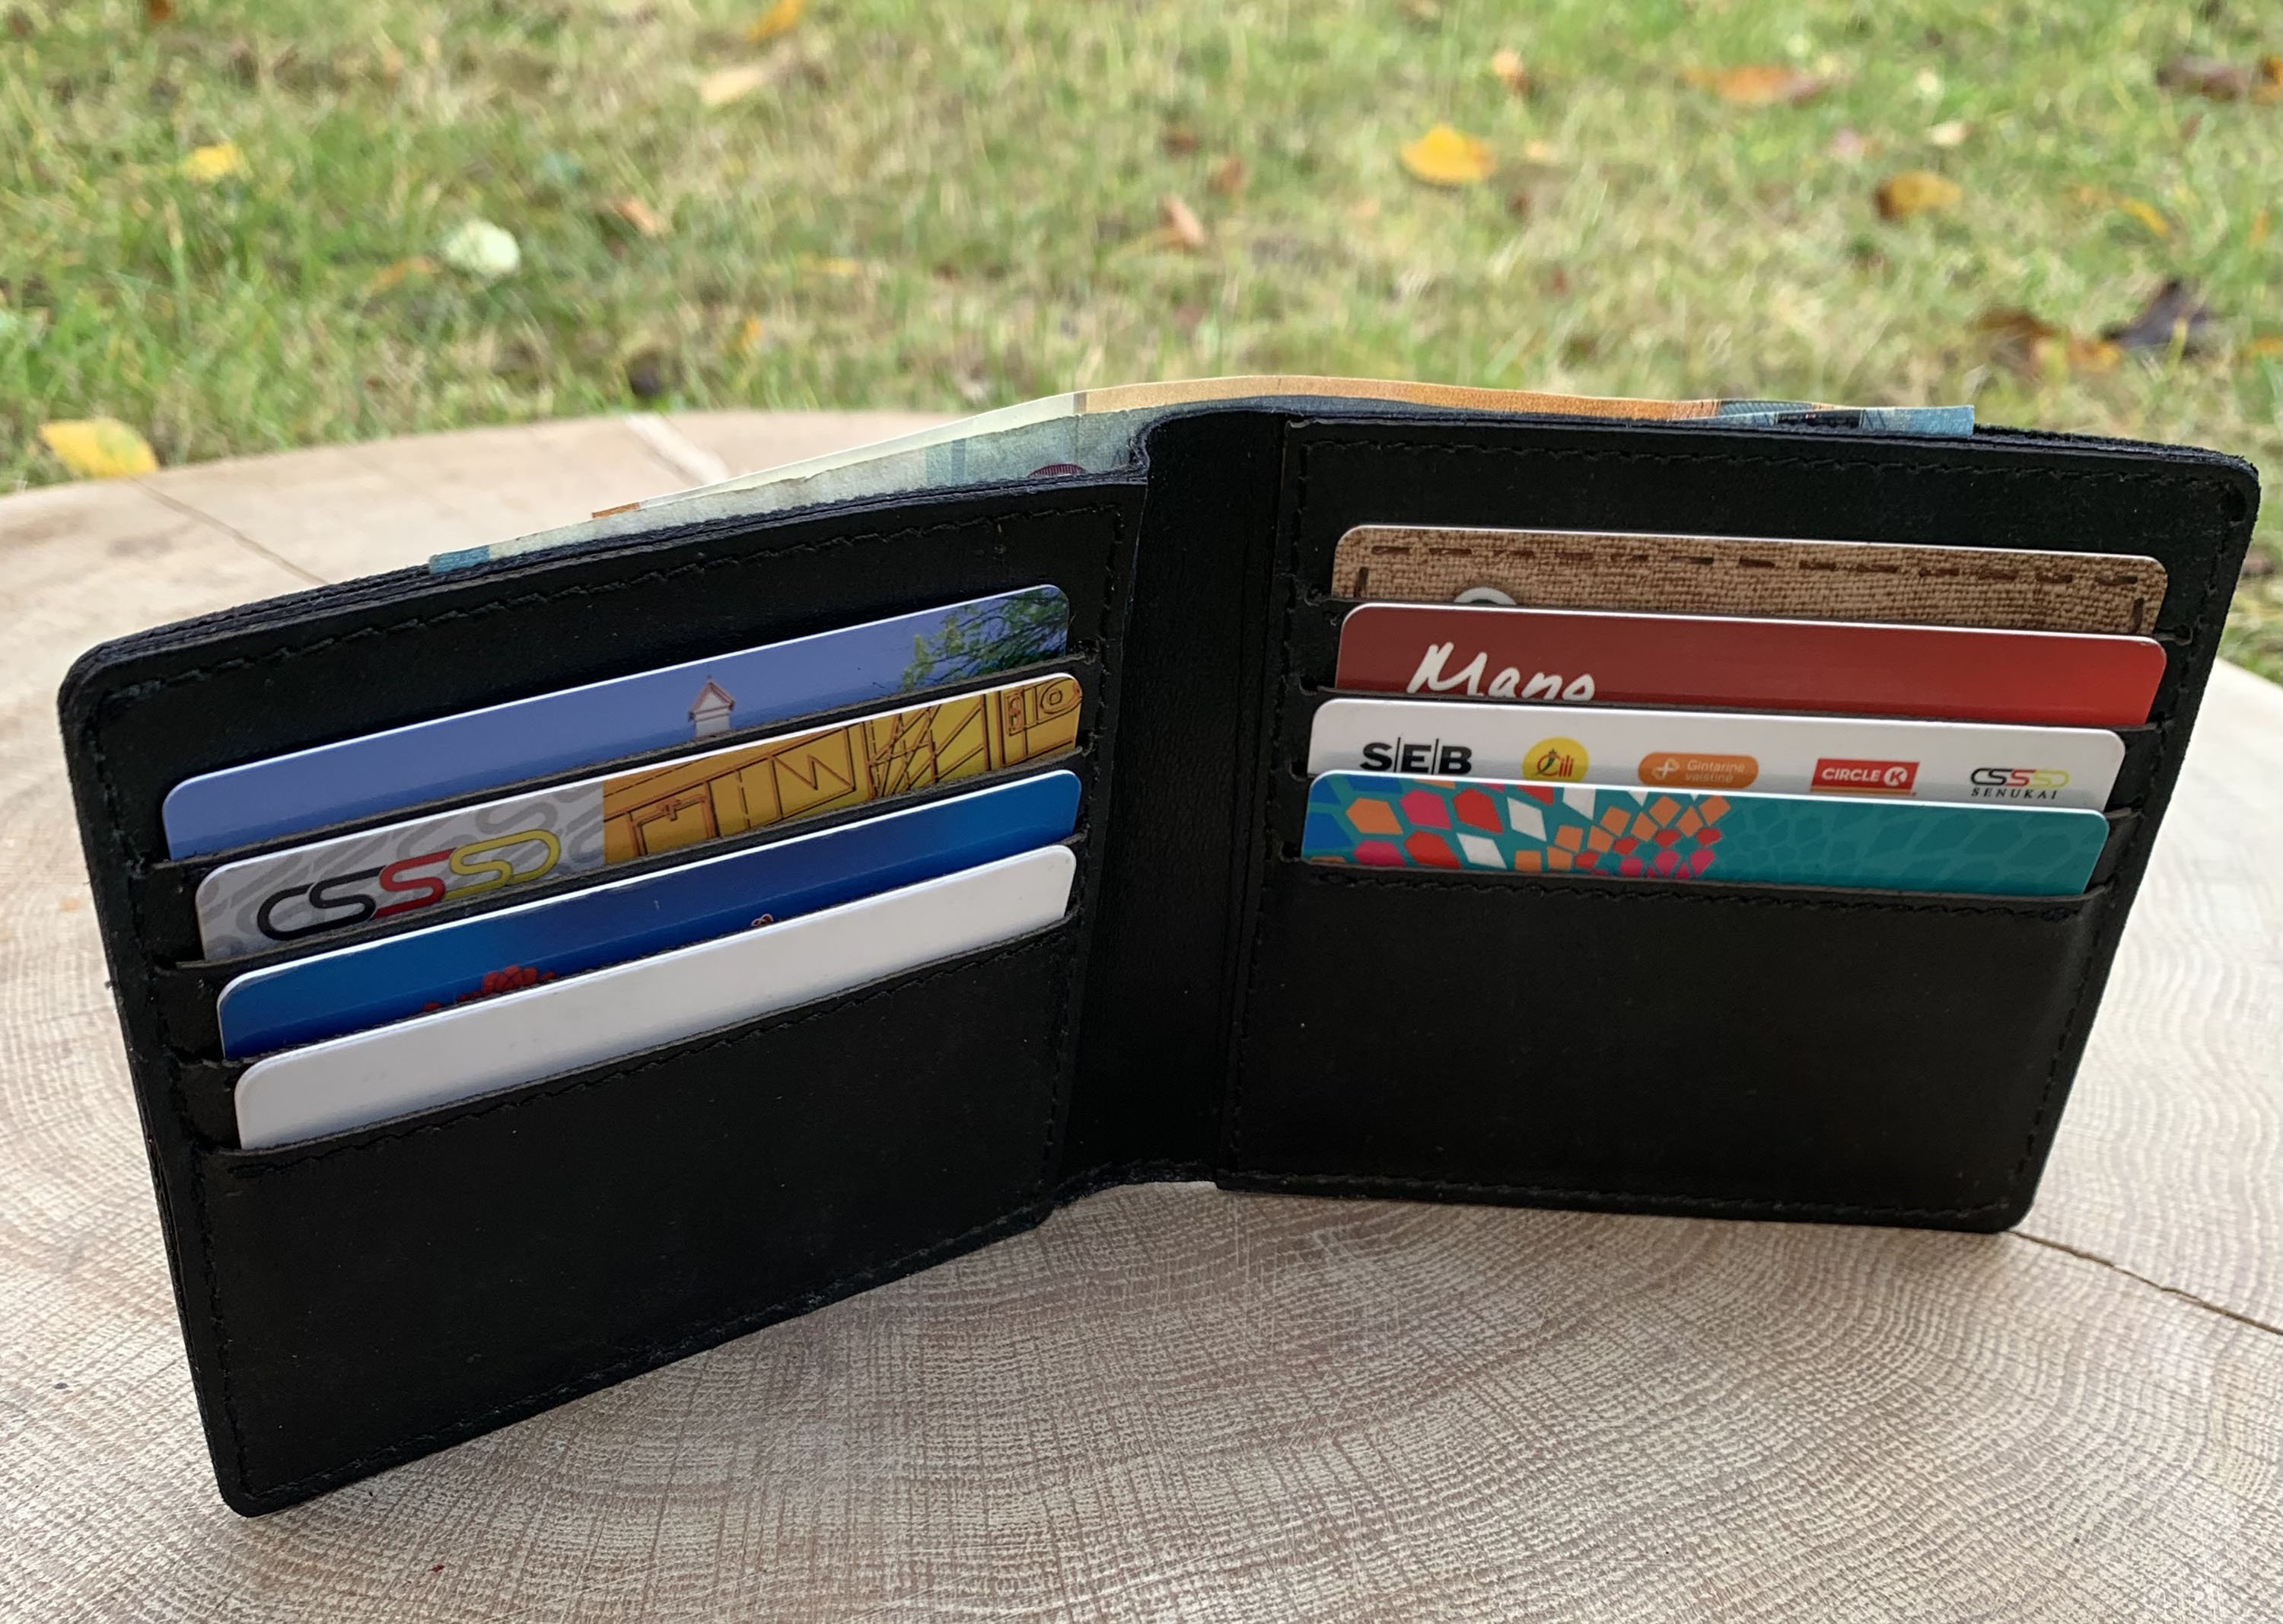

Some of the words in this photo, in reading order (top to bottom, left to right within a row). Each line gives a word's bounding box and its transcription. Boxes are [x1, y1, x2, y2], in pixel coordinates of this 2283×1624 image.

[1406, 642, 1595, 700] Mano
[1821, 766, 1880, 782] CIRCLE
[1886, 767, 1907, 785] K
[1971, 787, 2059, 800] SENUKAI
